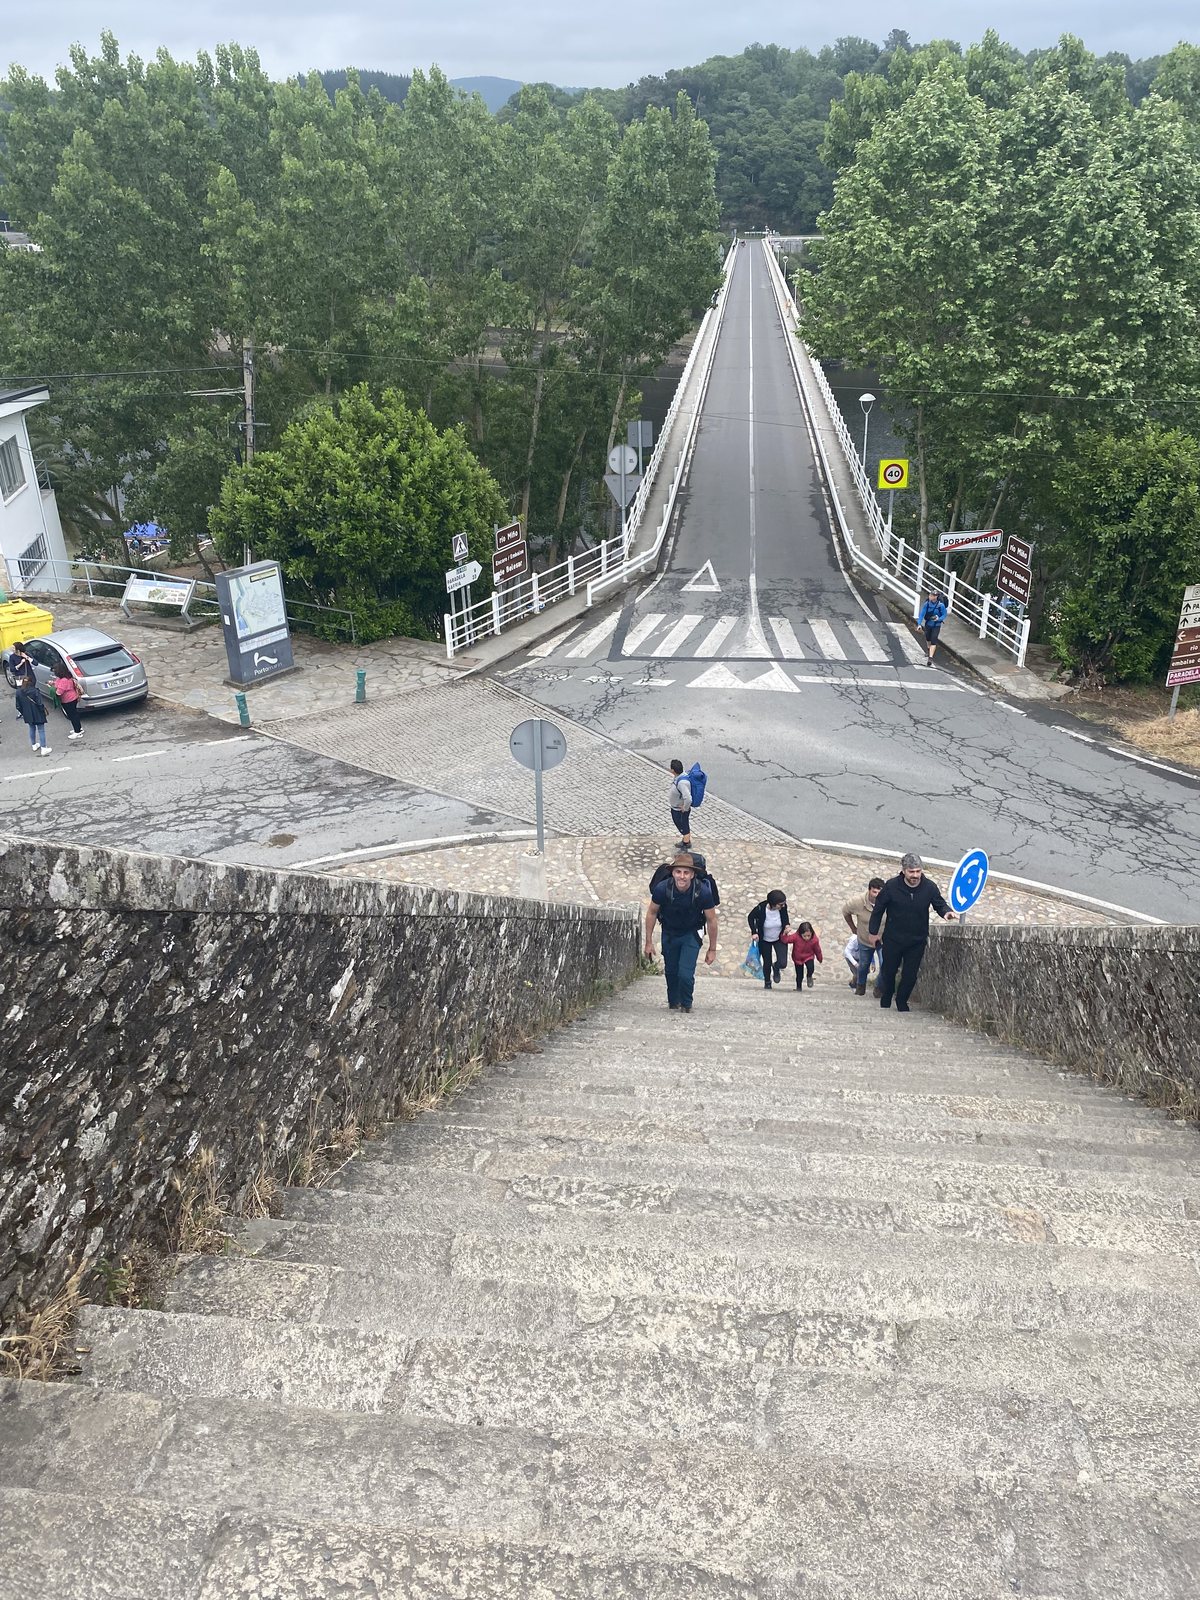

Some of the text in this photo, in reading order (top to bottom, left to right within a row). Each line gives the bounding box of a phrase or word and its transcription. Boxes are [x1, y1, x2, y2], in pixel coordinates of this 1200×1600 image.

[943, 536, 998, 546] PORTOMARIN
[1001, 576, 1025, 595] de Belesar
[1171, 659, 1195, 667] embalse
[1170, 669, 1199, 680] PARADELA
